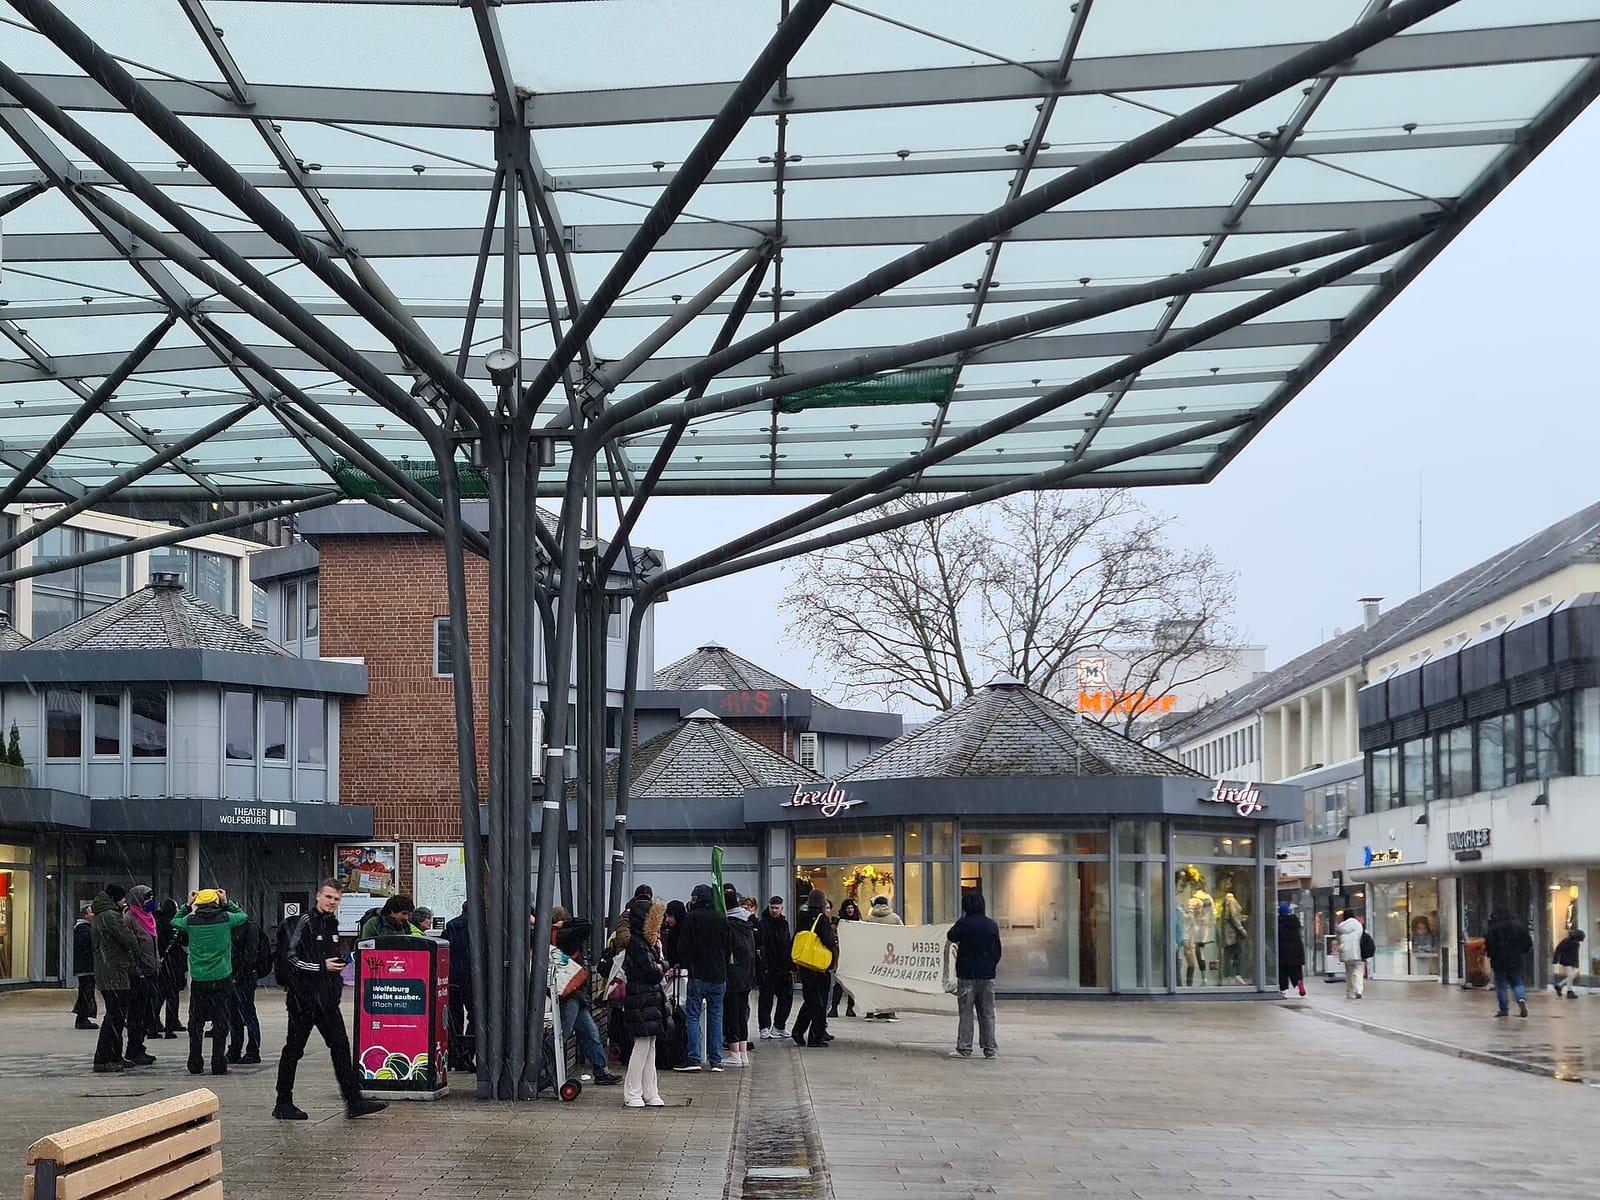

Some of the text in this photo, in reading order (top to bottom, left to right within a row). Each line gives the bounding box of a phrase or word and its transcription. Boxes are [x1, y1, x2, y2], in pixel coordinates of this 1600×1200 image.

[1078, 691, 1177, 713] Müller
[790, 780, 849, 818] tredy
[1211, 780, 1262, 816] tredy
[219, 815, 267, 825] WOLFSBURG
[233, 807, 267, 817] THEATER
[372, 985, 410, 994] Wolfsburg
